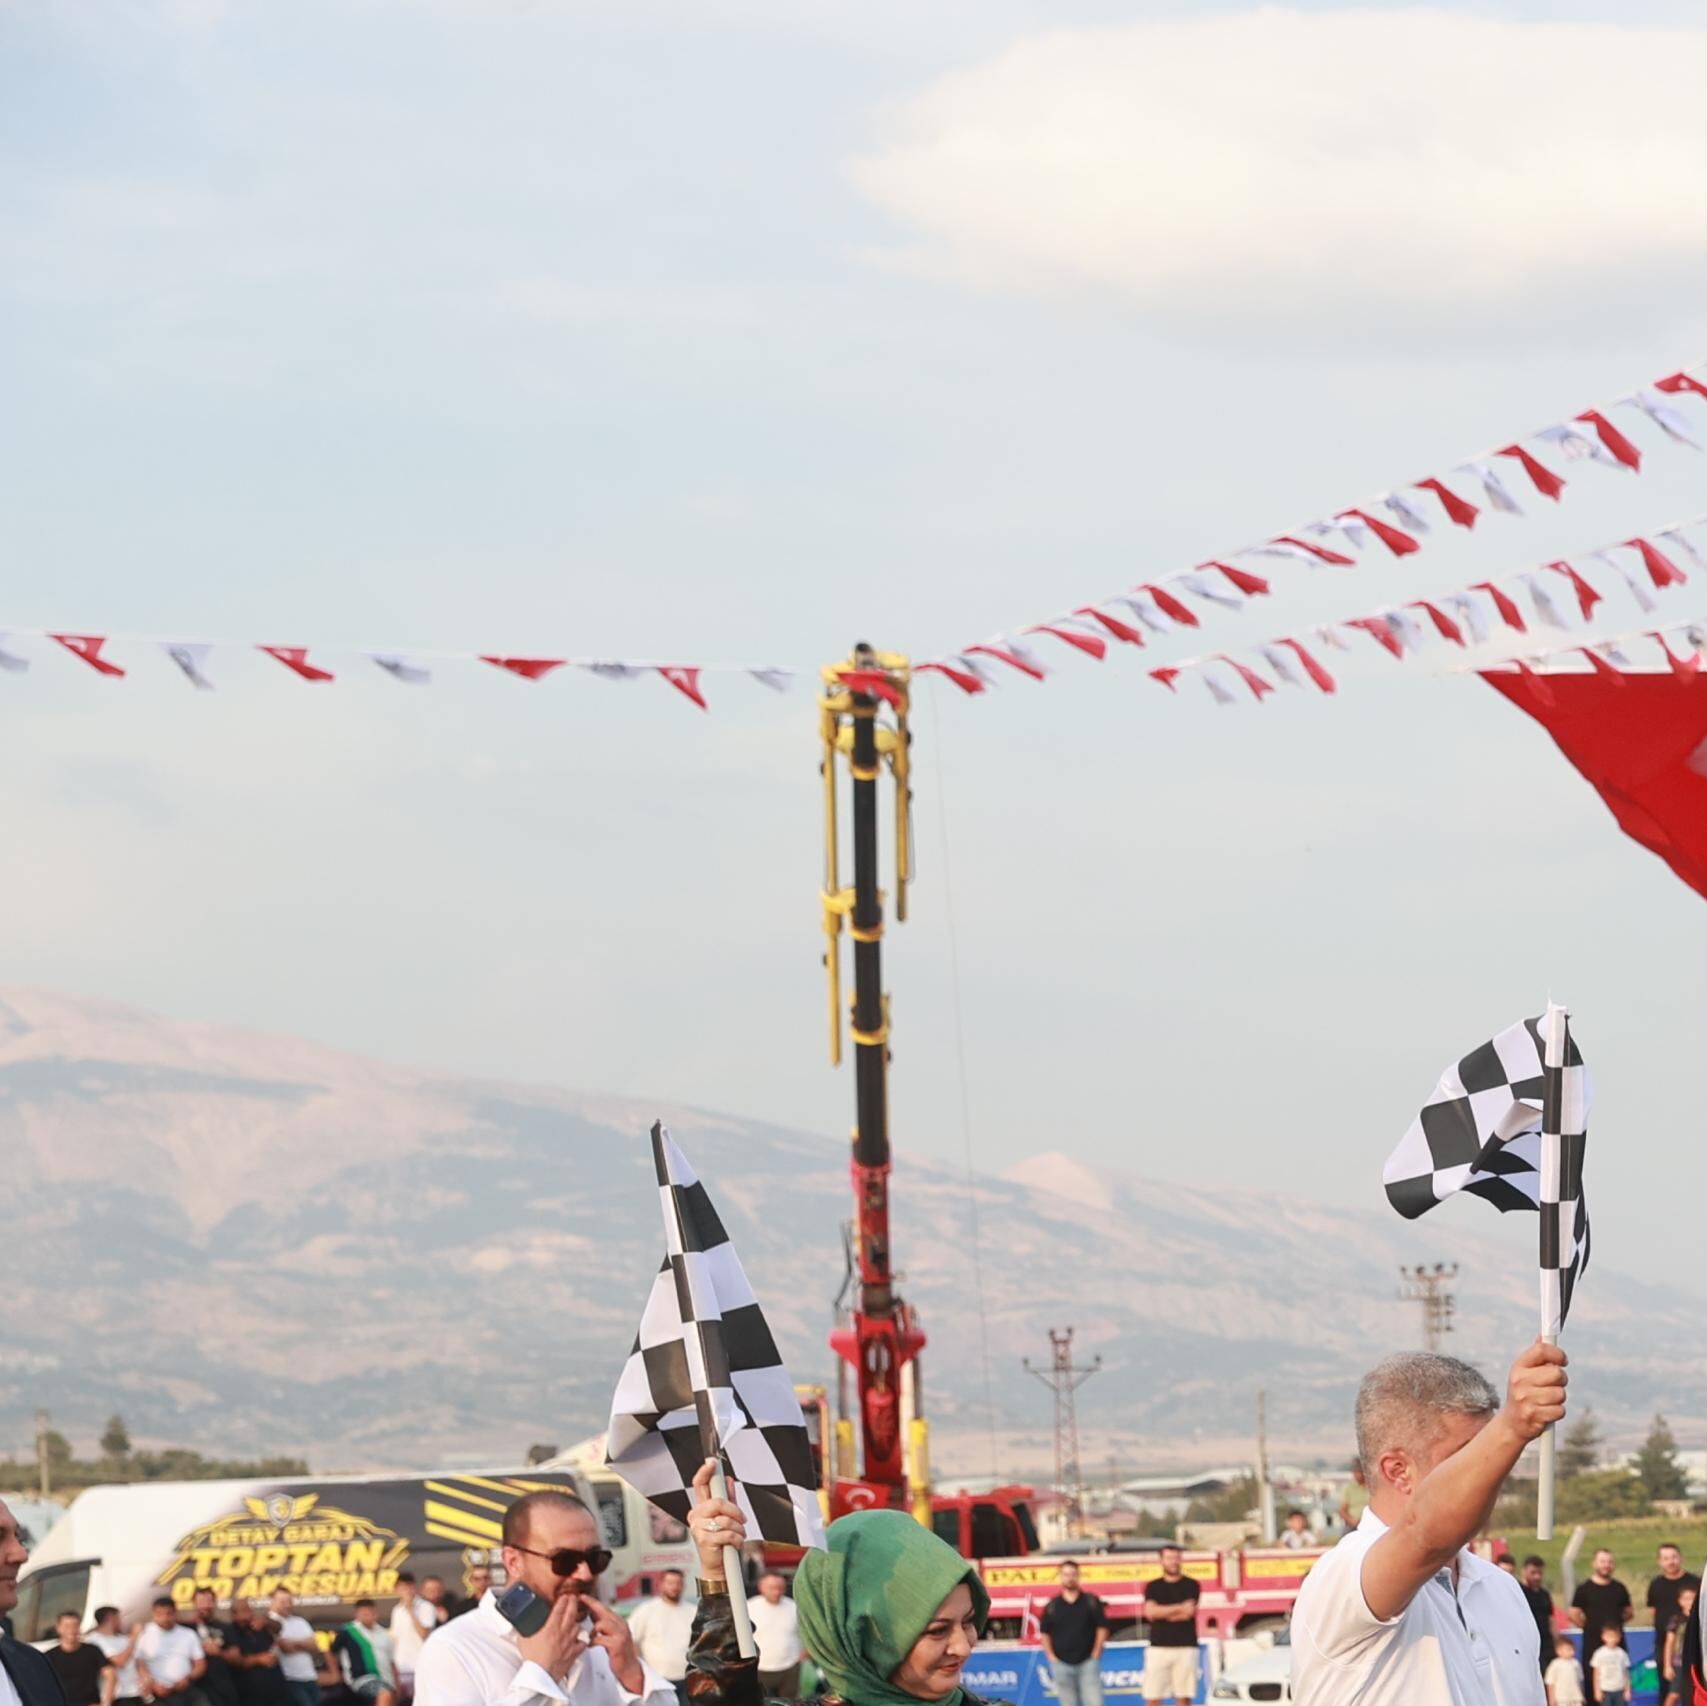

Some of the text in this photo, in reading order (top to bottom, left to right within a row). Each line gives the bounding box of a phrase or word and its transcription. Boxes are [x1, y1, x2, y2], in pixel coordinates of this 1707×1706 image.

[209, 1524, 355, 1546] DETAY GARAJ
[190, 1539, 386, 1579] TOPTAN
[236, 1569, 400, 1599] AKSESUAR
